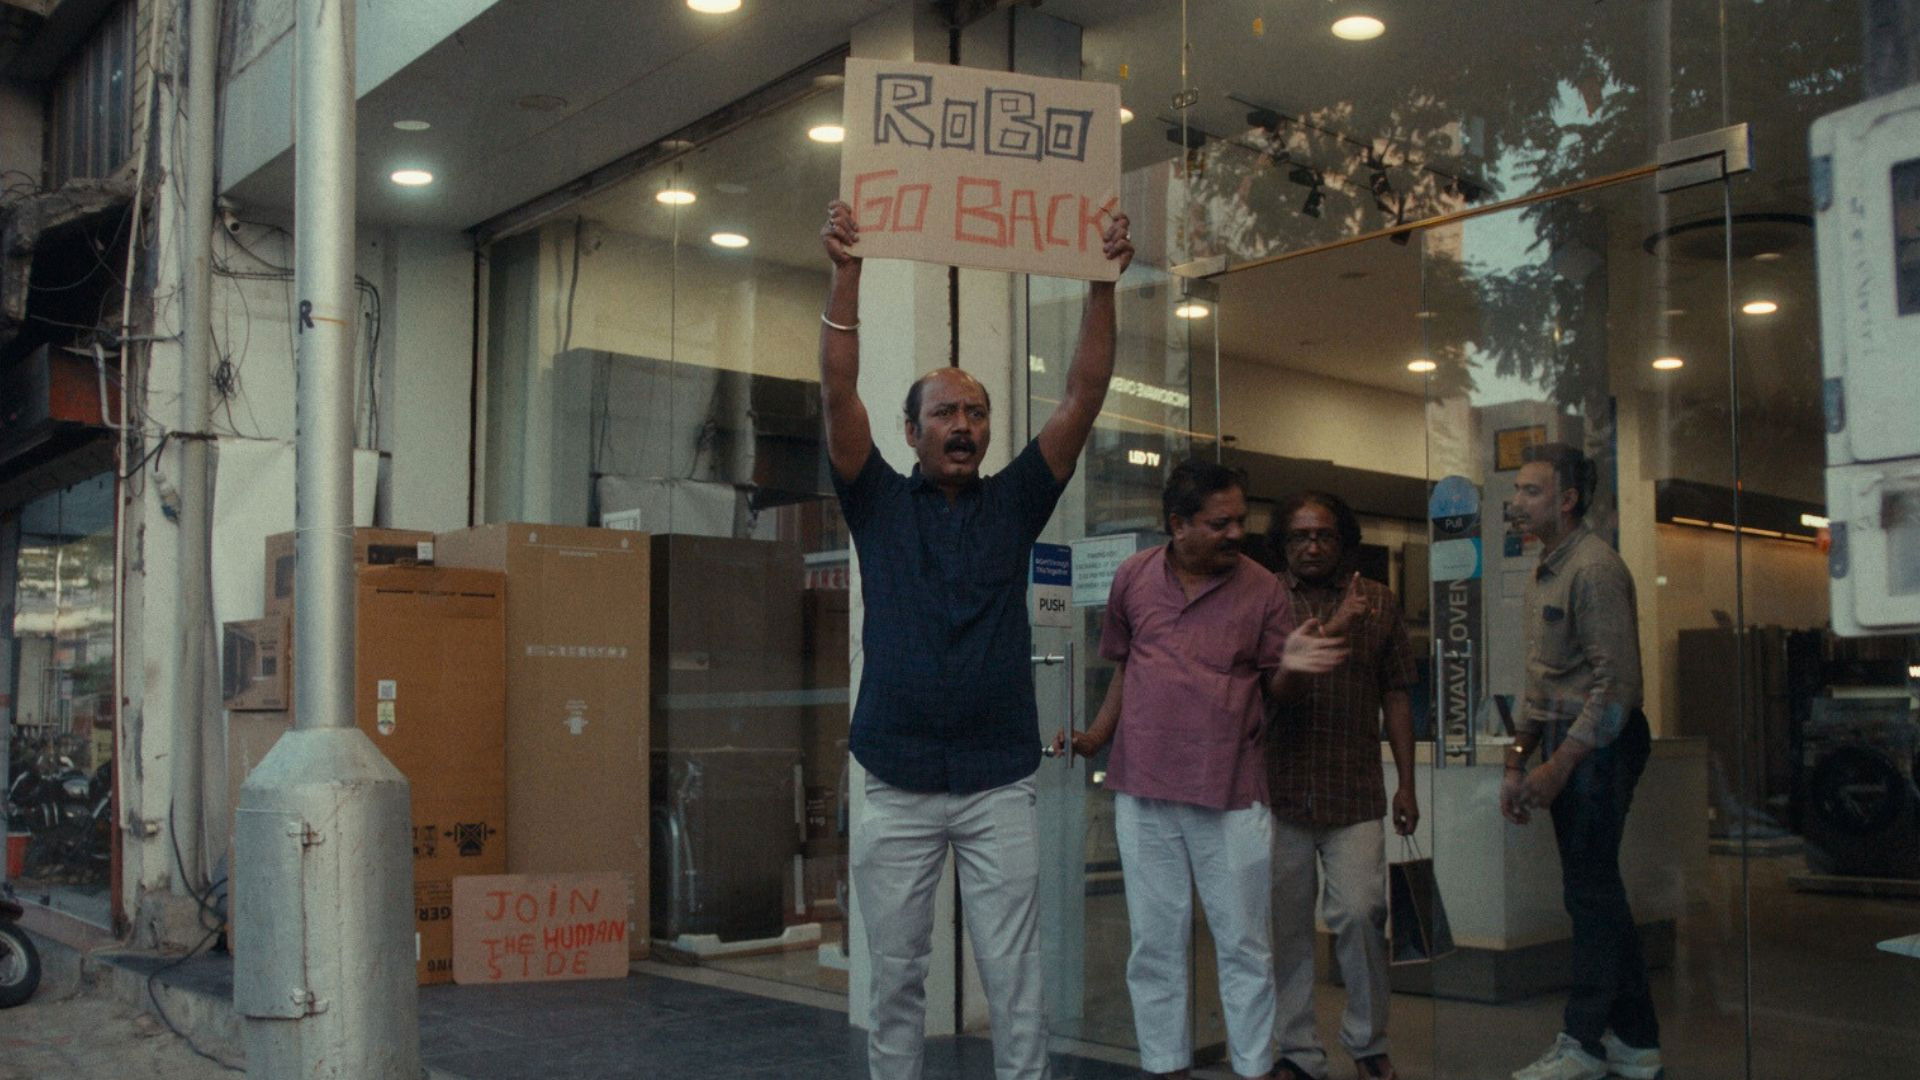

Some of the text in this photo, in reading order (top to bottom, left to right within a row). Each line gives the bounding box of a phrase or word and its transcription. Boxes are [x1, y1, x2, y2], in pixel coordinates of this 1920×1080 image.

[853, 169, 1118, 252] GO BACK
[299, 299, 315, 335] R
[1128, 449, 1161, 467] LED TV
[1040, 598, 1066, 612] PUSH
[482, 919, 626, 959] THE HUMAN
[488, 951, 590, 980] SIDE
